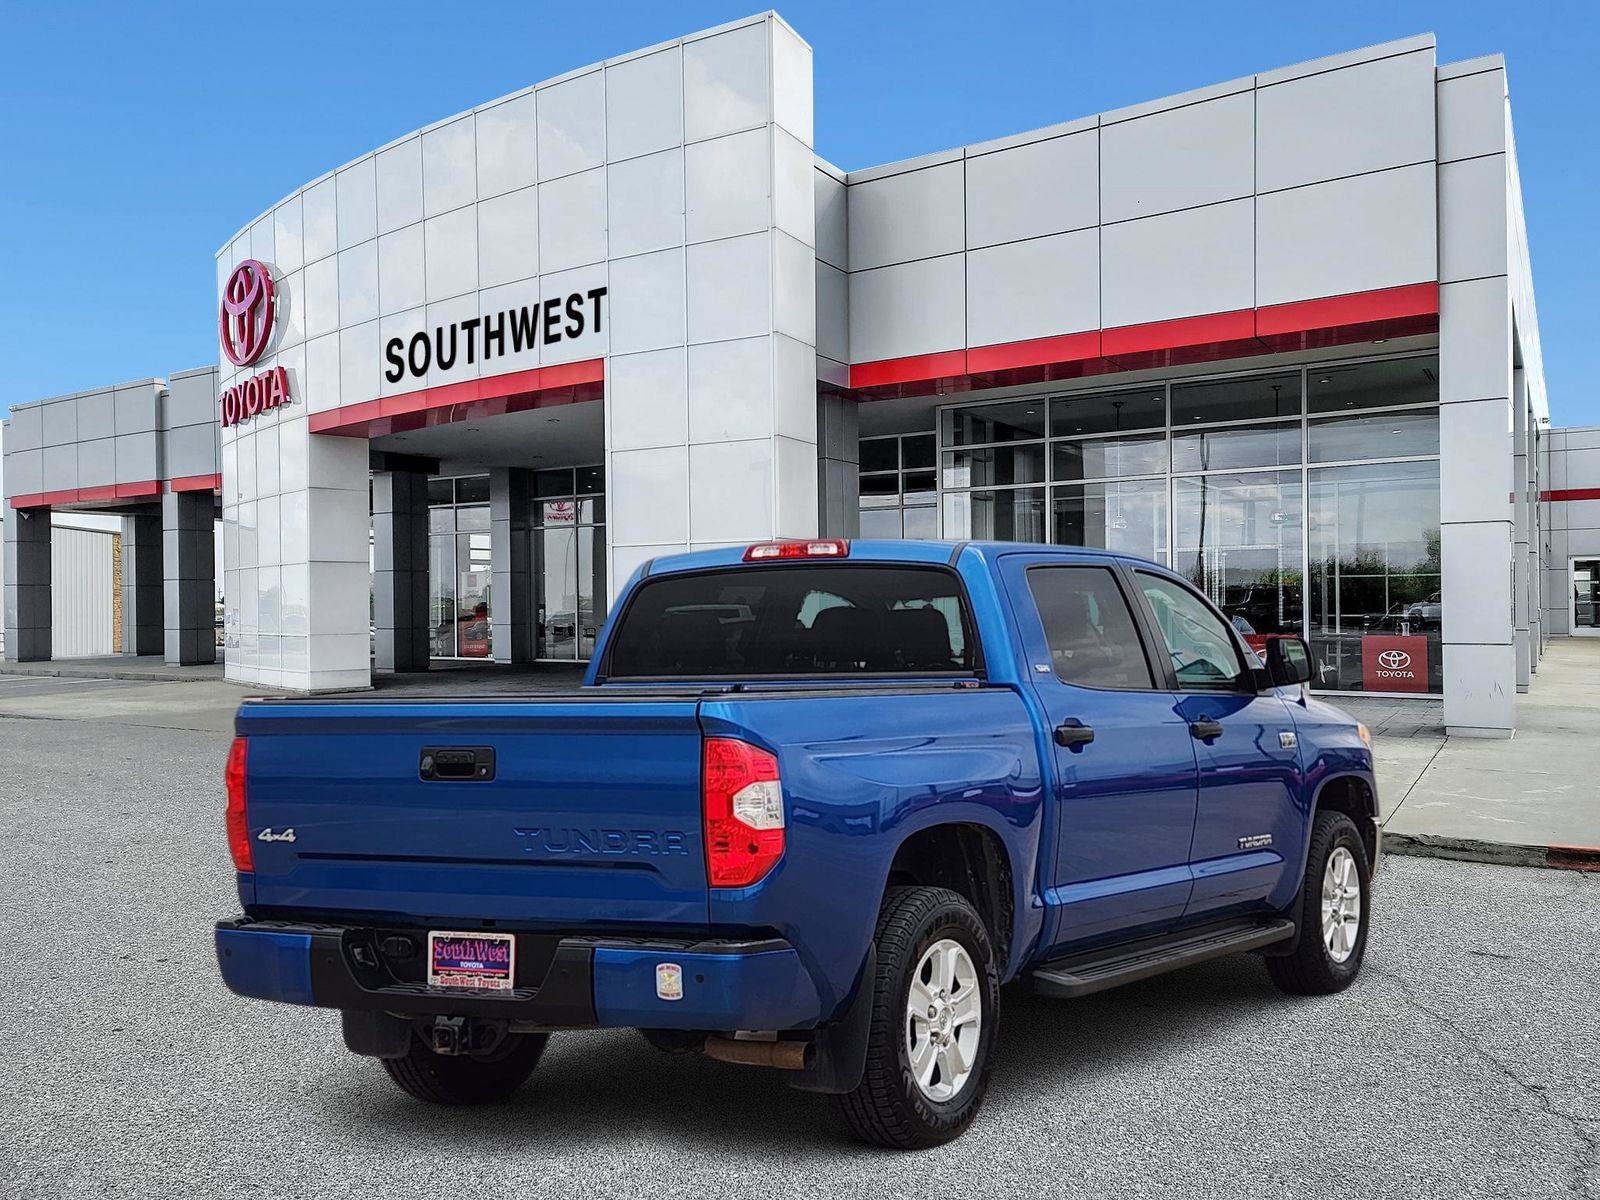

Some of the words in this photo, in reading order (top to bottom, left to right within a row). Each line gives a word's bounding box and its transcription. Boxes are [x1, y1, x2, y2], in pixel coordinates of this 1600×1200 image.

[385, 286, 608, 384] SOUTHWEST
[218, 366, 291, 427] TOYOTA
[1376, 670, 1415, 678] TOYOTA
[257, 828, 296, 842] 4x4
[513, 827, 689, 855] TUNDRA
